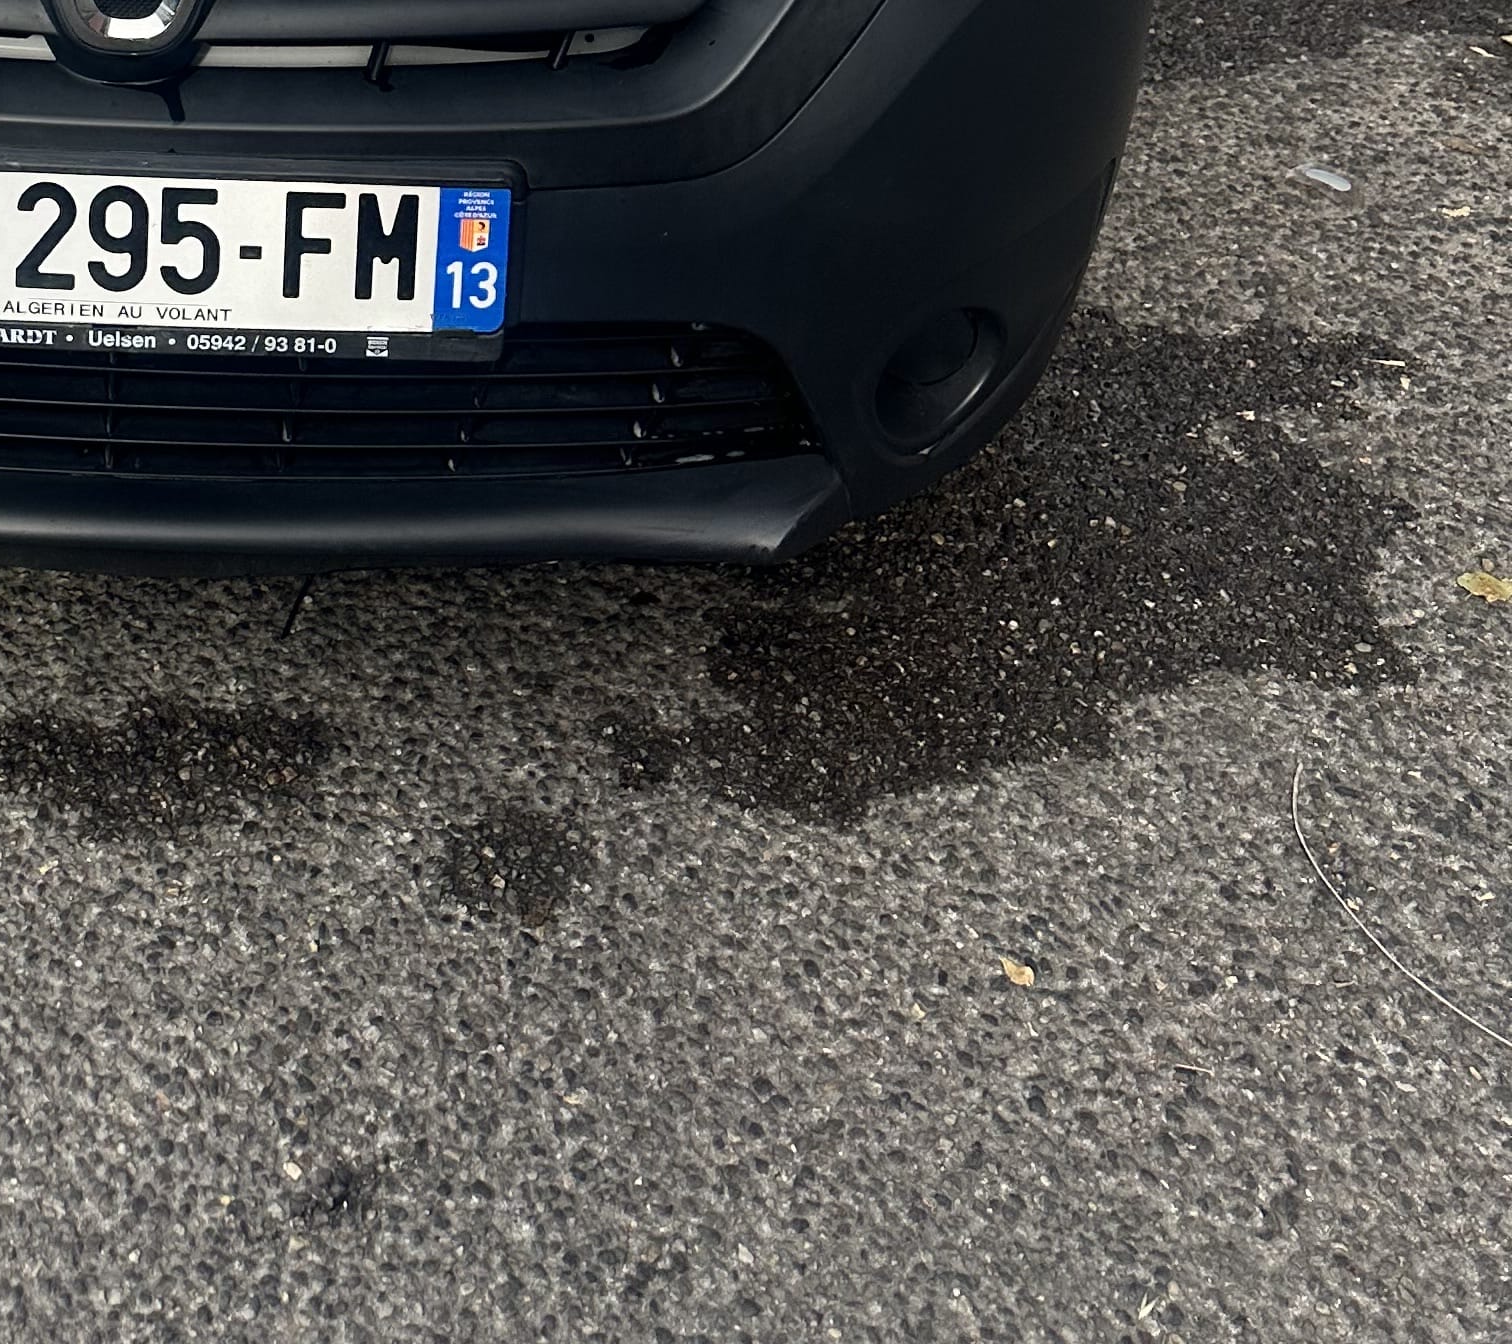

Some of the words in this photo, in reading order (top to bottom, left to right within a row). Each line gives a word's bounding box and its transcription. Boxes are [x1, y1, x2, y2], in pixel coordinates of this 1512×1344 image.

[446, 260, 498, 309] 13
[3, 300, 104, 317] ALGERIEN
[118, 305, 142, 319] AU
[156, 306, 232, 321] VOLANT
[88, 330, 156, 348] Uelsen
[187, 334, 246, 351] 05942
[264, 336, 288, 352] 93
[294, 338, 337, 353] 81-0
